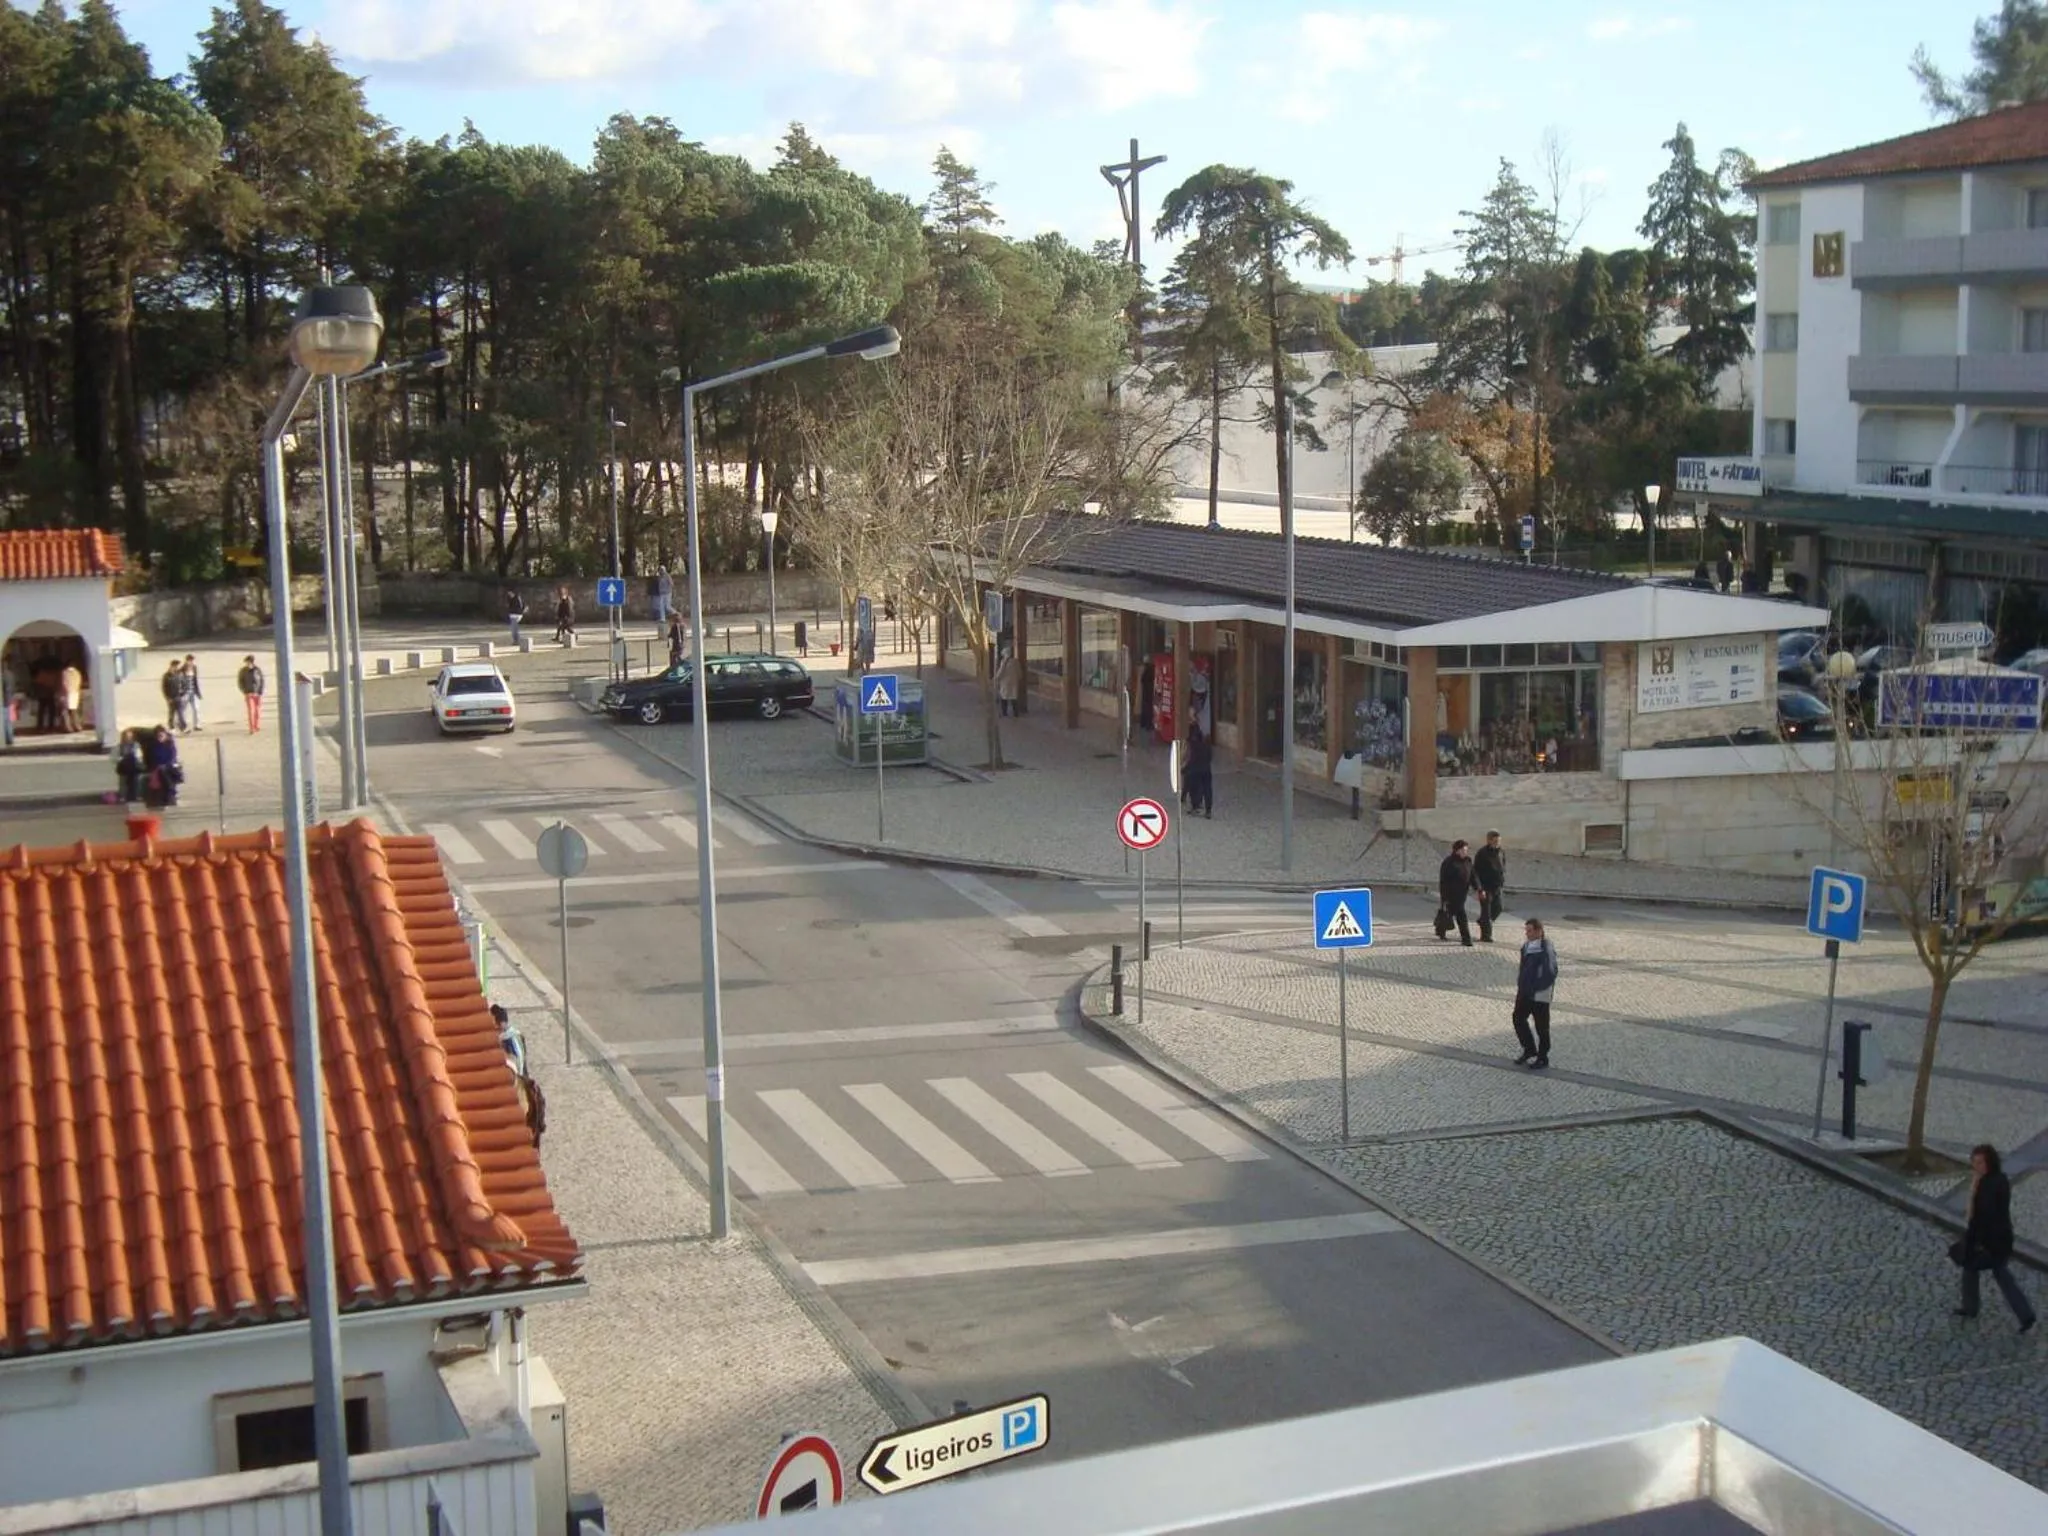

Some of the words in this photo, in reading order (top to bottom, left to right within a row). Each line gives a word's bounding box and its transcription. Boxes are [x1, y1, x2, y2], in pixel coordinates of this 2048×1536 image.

[1932, 630, 1983, 645] museu
[1818, 876, 1853, 929] P
[905, 1432, 993, 1472] ligeiros
[1008, 1410, 1031, 1448] P
